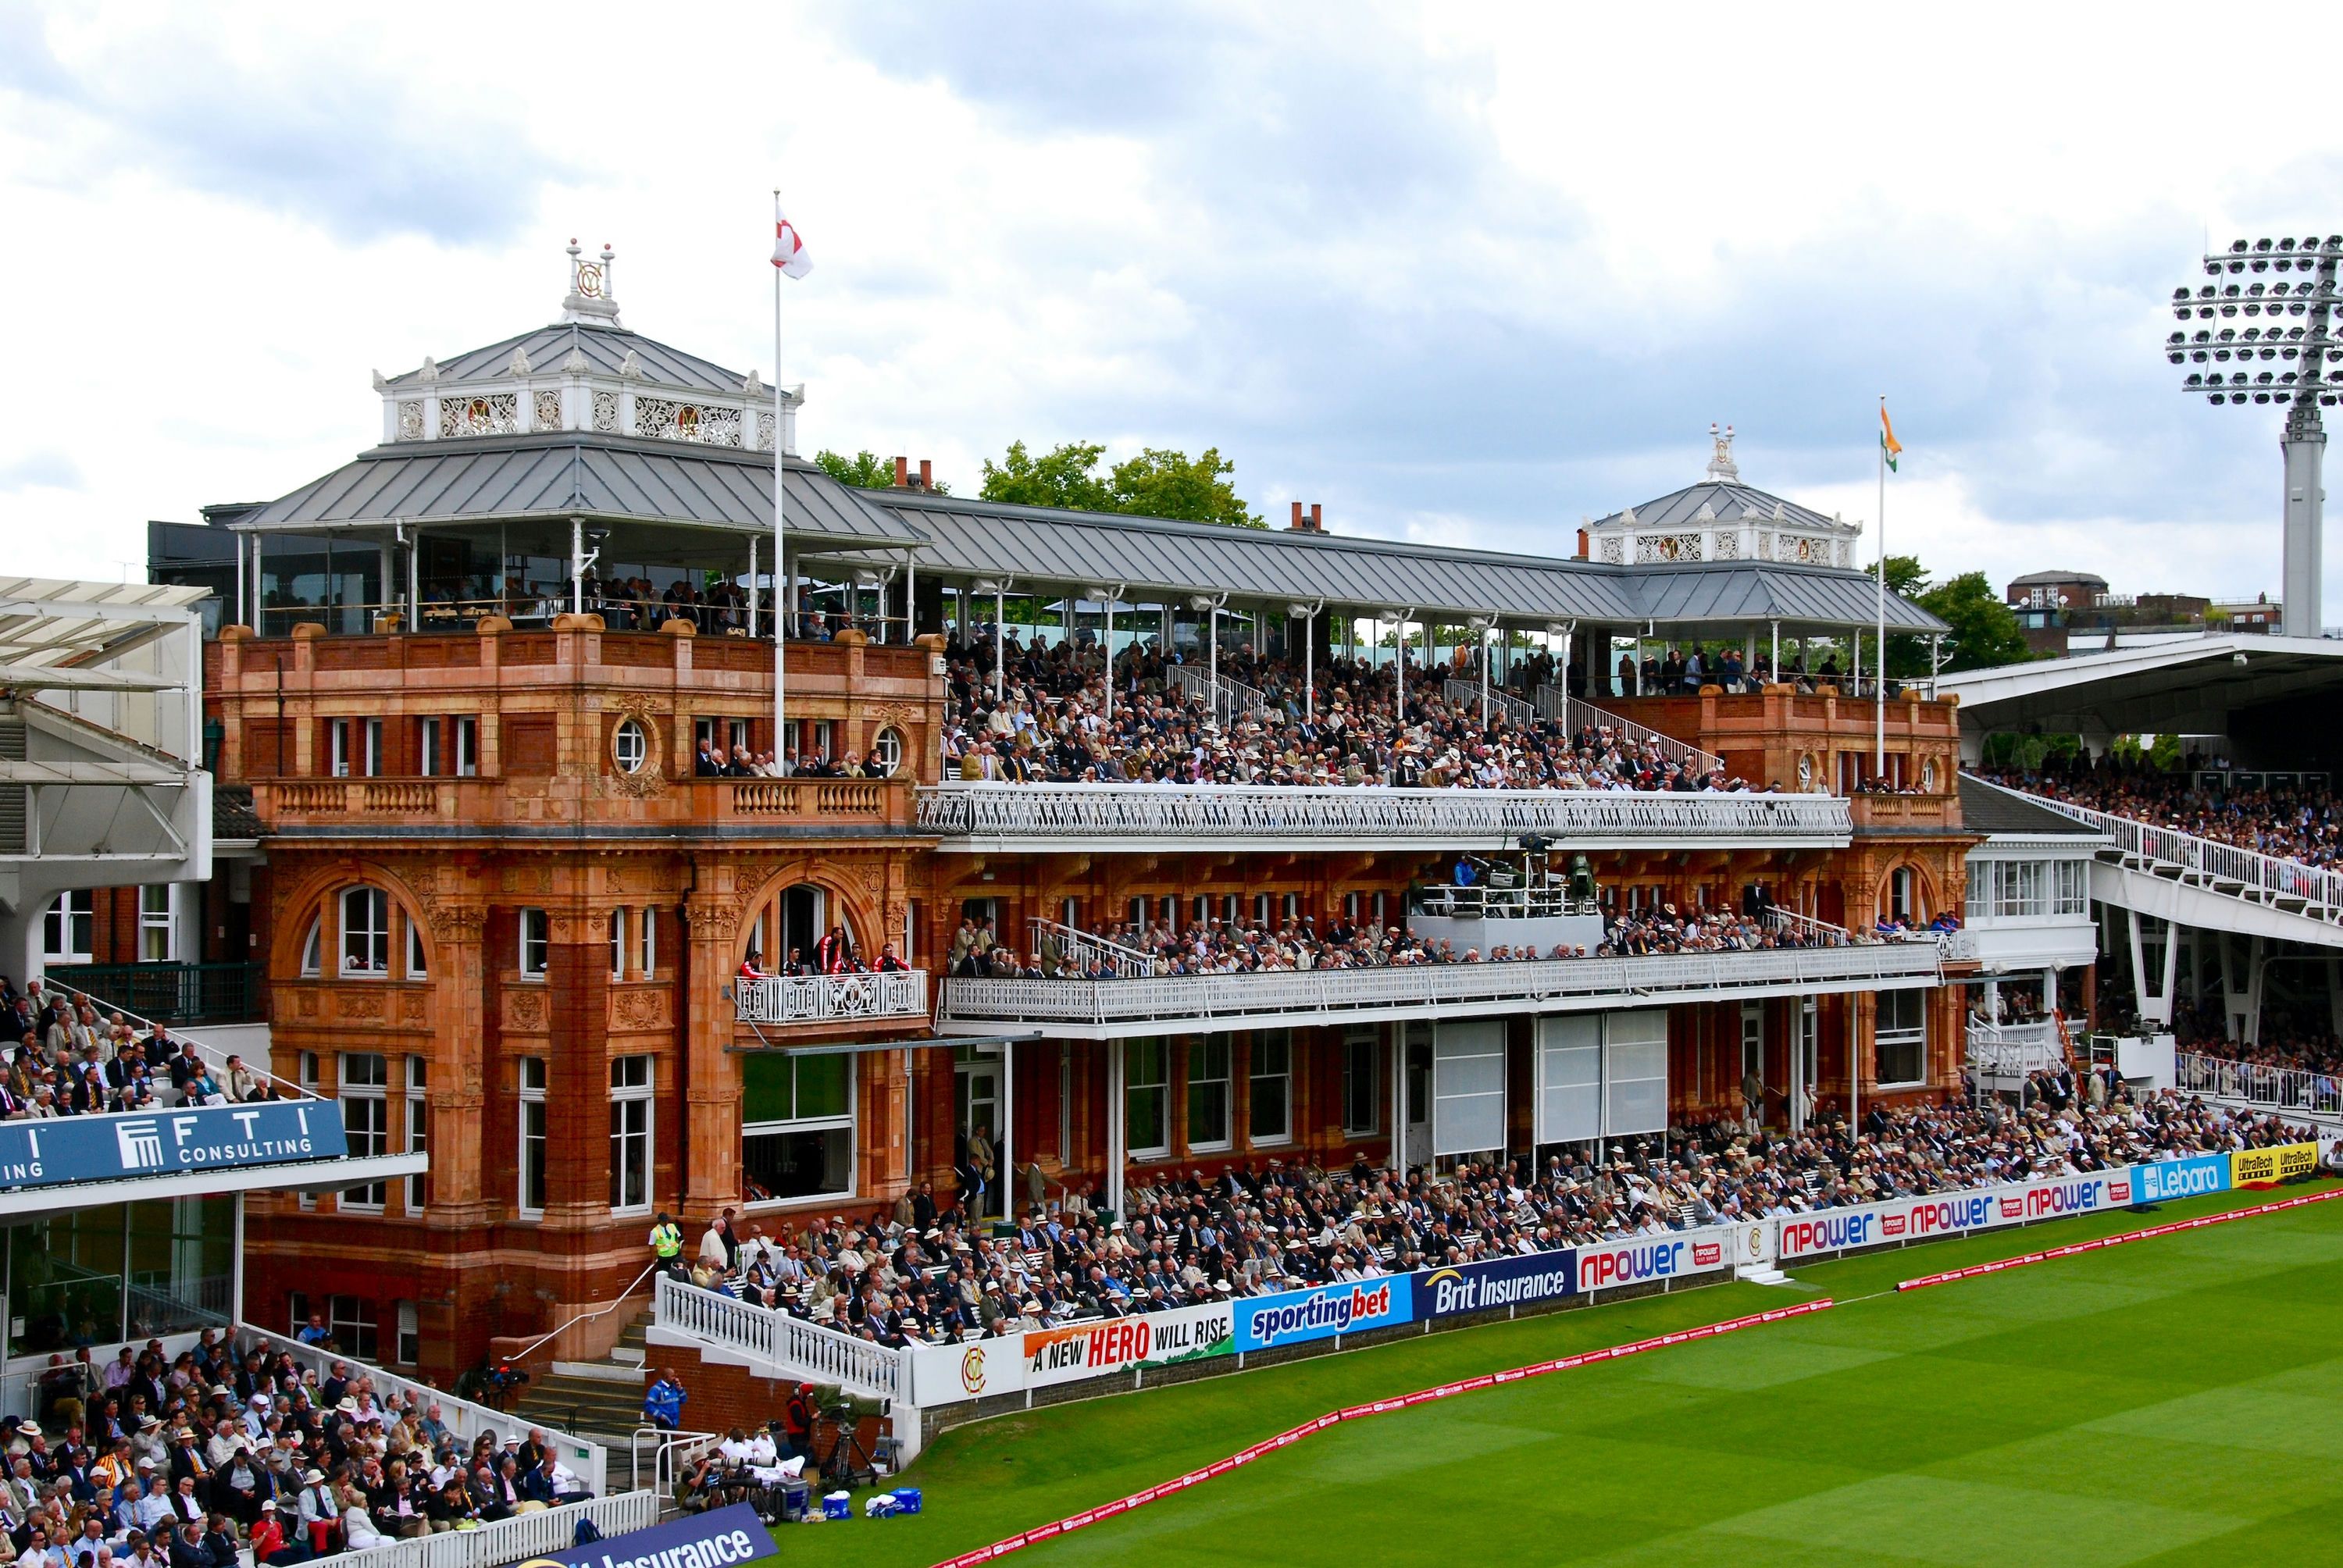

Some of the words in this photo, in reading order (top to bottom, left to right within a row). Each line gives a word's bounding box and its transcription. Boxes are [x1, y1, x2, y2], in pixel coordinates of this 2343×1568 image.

[179, 1138, 312, 1164] CONSULTING
[2238, 1155, 2273, 1171] UltraTech
[2281, 1150, 2313, 1165] UltraTech
[2159, 1164, 2218, 1196] Lebara
[1435, 1277, 1476, 1313] Brit
[1480, 1270, 1564, 1306] Insurance
[1252, 1284, 1389, 1343] sportingbet
[1032, 1349, 1043, 1373] A
[1049, 1341, 1084, 1369] NEW
[1088, 1321, 1150, 1367] HERO
[1155, 1320, 1189, 1351] WILL
[1195, 1317, 1228, 1344] RISE
